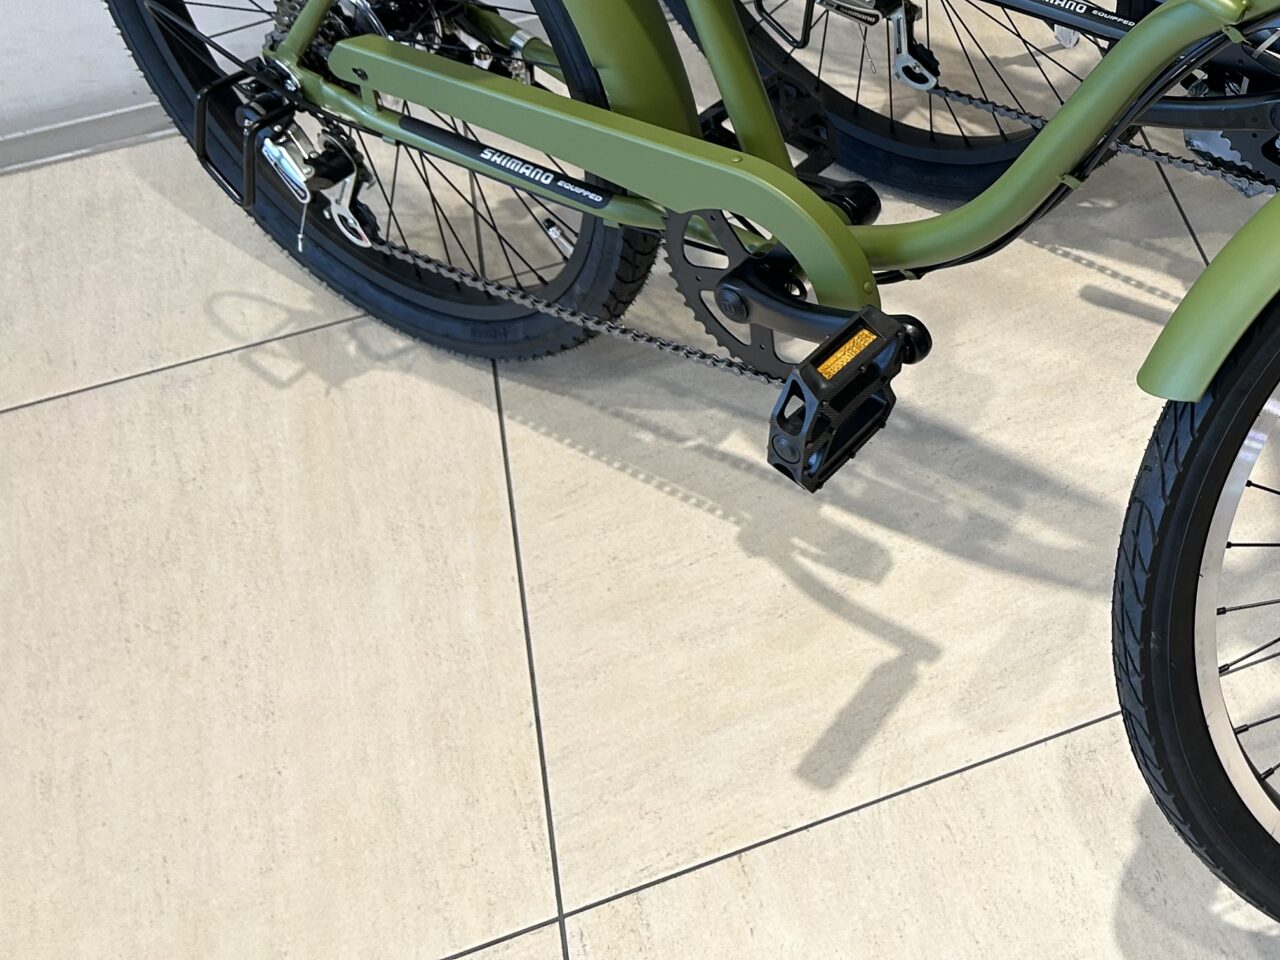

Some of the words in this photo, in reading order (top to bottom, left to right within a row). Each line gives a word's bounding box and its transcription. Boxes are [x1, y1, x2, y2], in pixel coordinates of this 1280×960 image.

[1091, 8, 1136, 27] EQUIPPED
[480, 147, 554, 186] SHIMANO
[556, 179, 603, 202] EQUIPPED
